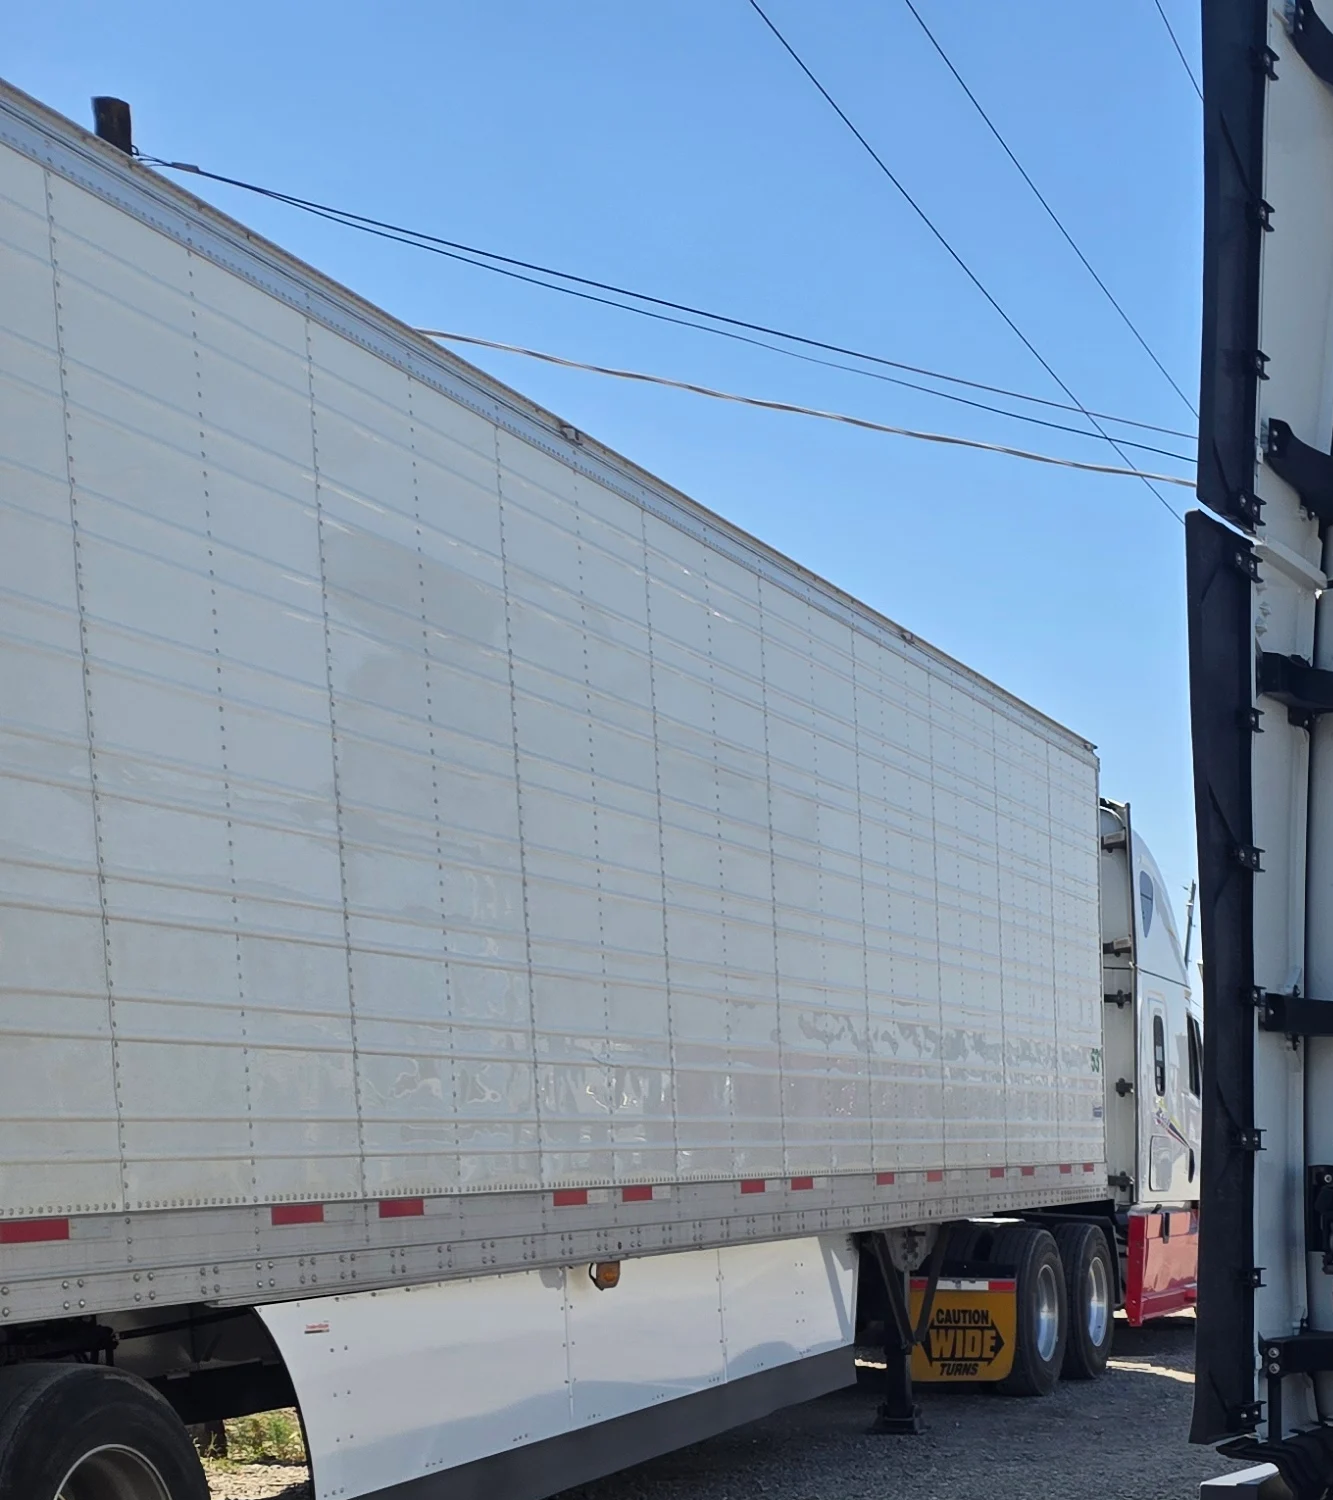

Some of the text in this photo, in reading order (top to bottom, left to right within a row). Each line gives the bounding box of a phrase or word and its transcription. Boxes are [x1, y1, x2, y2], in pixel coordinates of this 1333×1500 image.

[935, 1308, 990, 1325] CAUTION
[929, 1328, 997, 1359] WIDE
[940, 1362, 979, 1377] TURNS
